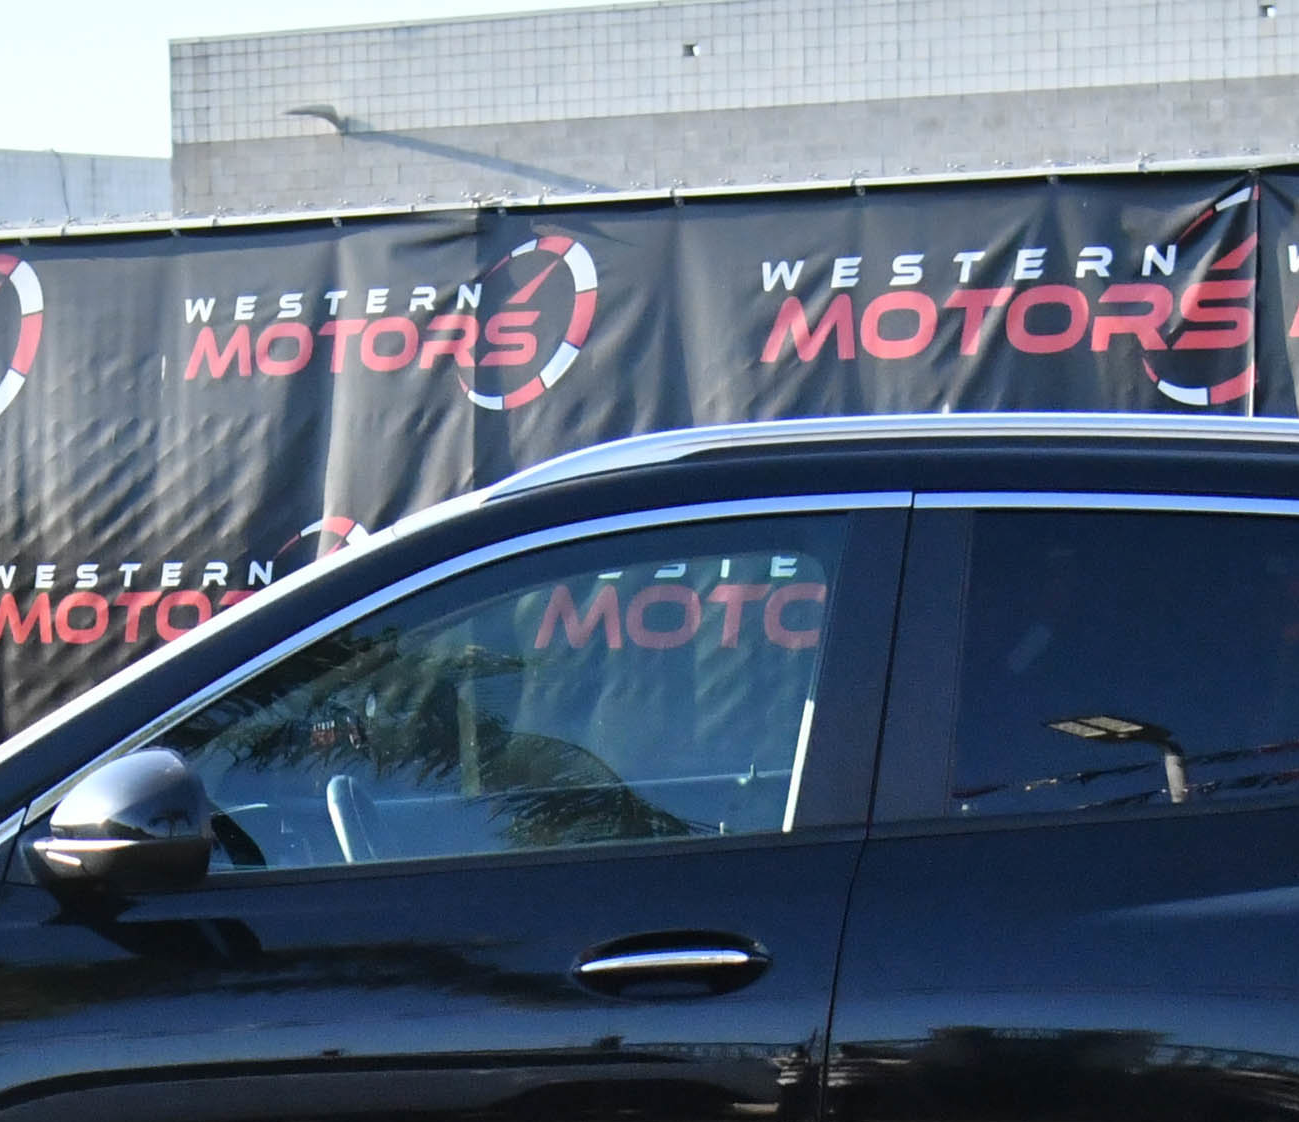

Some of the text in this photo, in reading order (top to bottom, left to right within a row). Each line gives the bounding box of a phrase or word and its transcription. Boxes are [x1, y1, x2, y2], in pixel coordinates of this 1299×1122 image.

[760, 243, 1178, 294] WESTERN
[184, 283, 483, 324] WESTERN
[760, 278, 1257, 363] MOTORS
[184, 309, 541, 381] MOTORS
